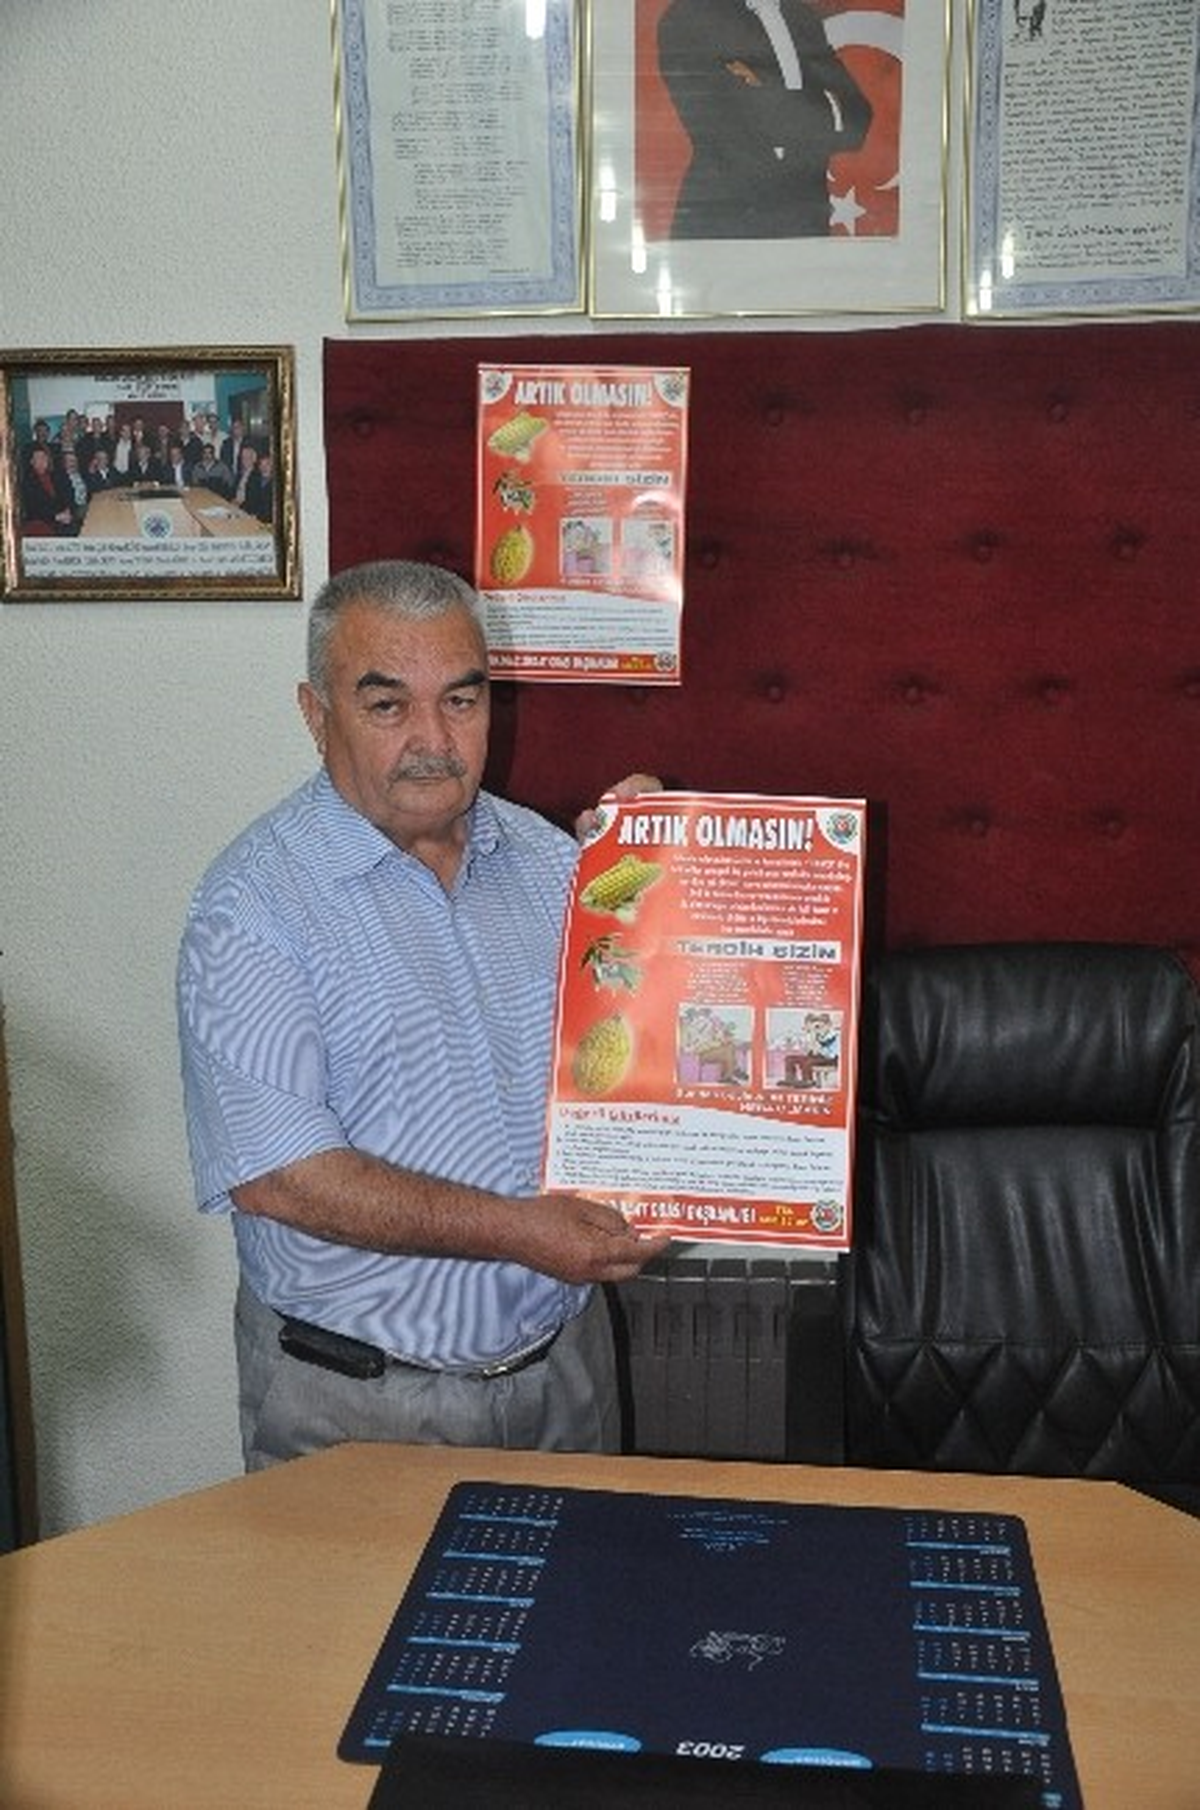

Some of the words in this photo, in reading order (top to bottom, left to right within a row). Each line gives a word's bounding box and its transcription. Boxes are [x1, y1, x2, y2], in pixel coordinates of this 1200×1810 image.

[515, 380, 566, 405] ARTIK
[617, 814, 688, 846] ARTIK
[695, 815, 814, 851] OLMASIN!
[676, 1741, 745, 1760] 2003
